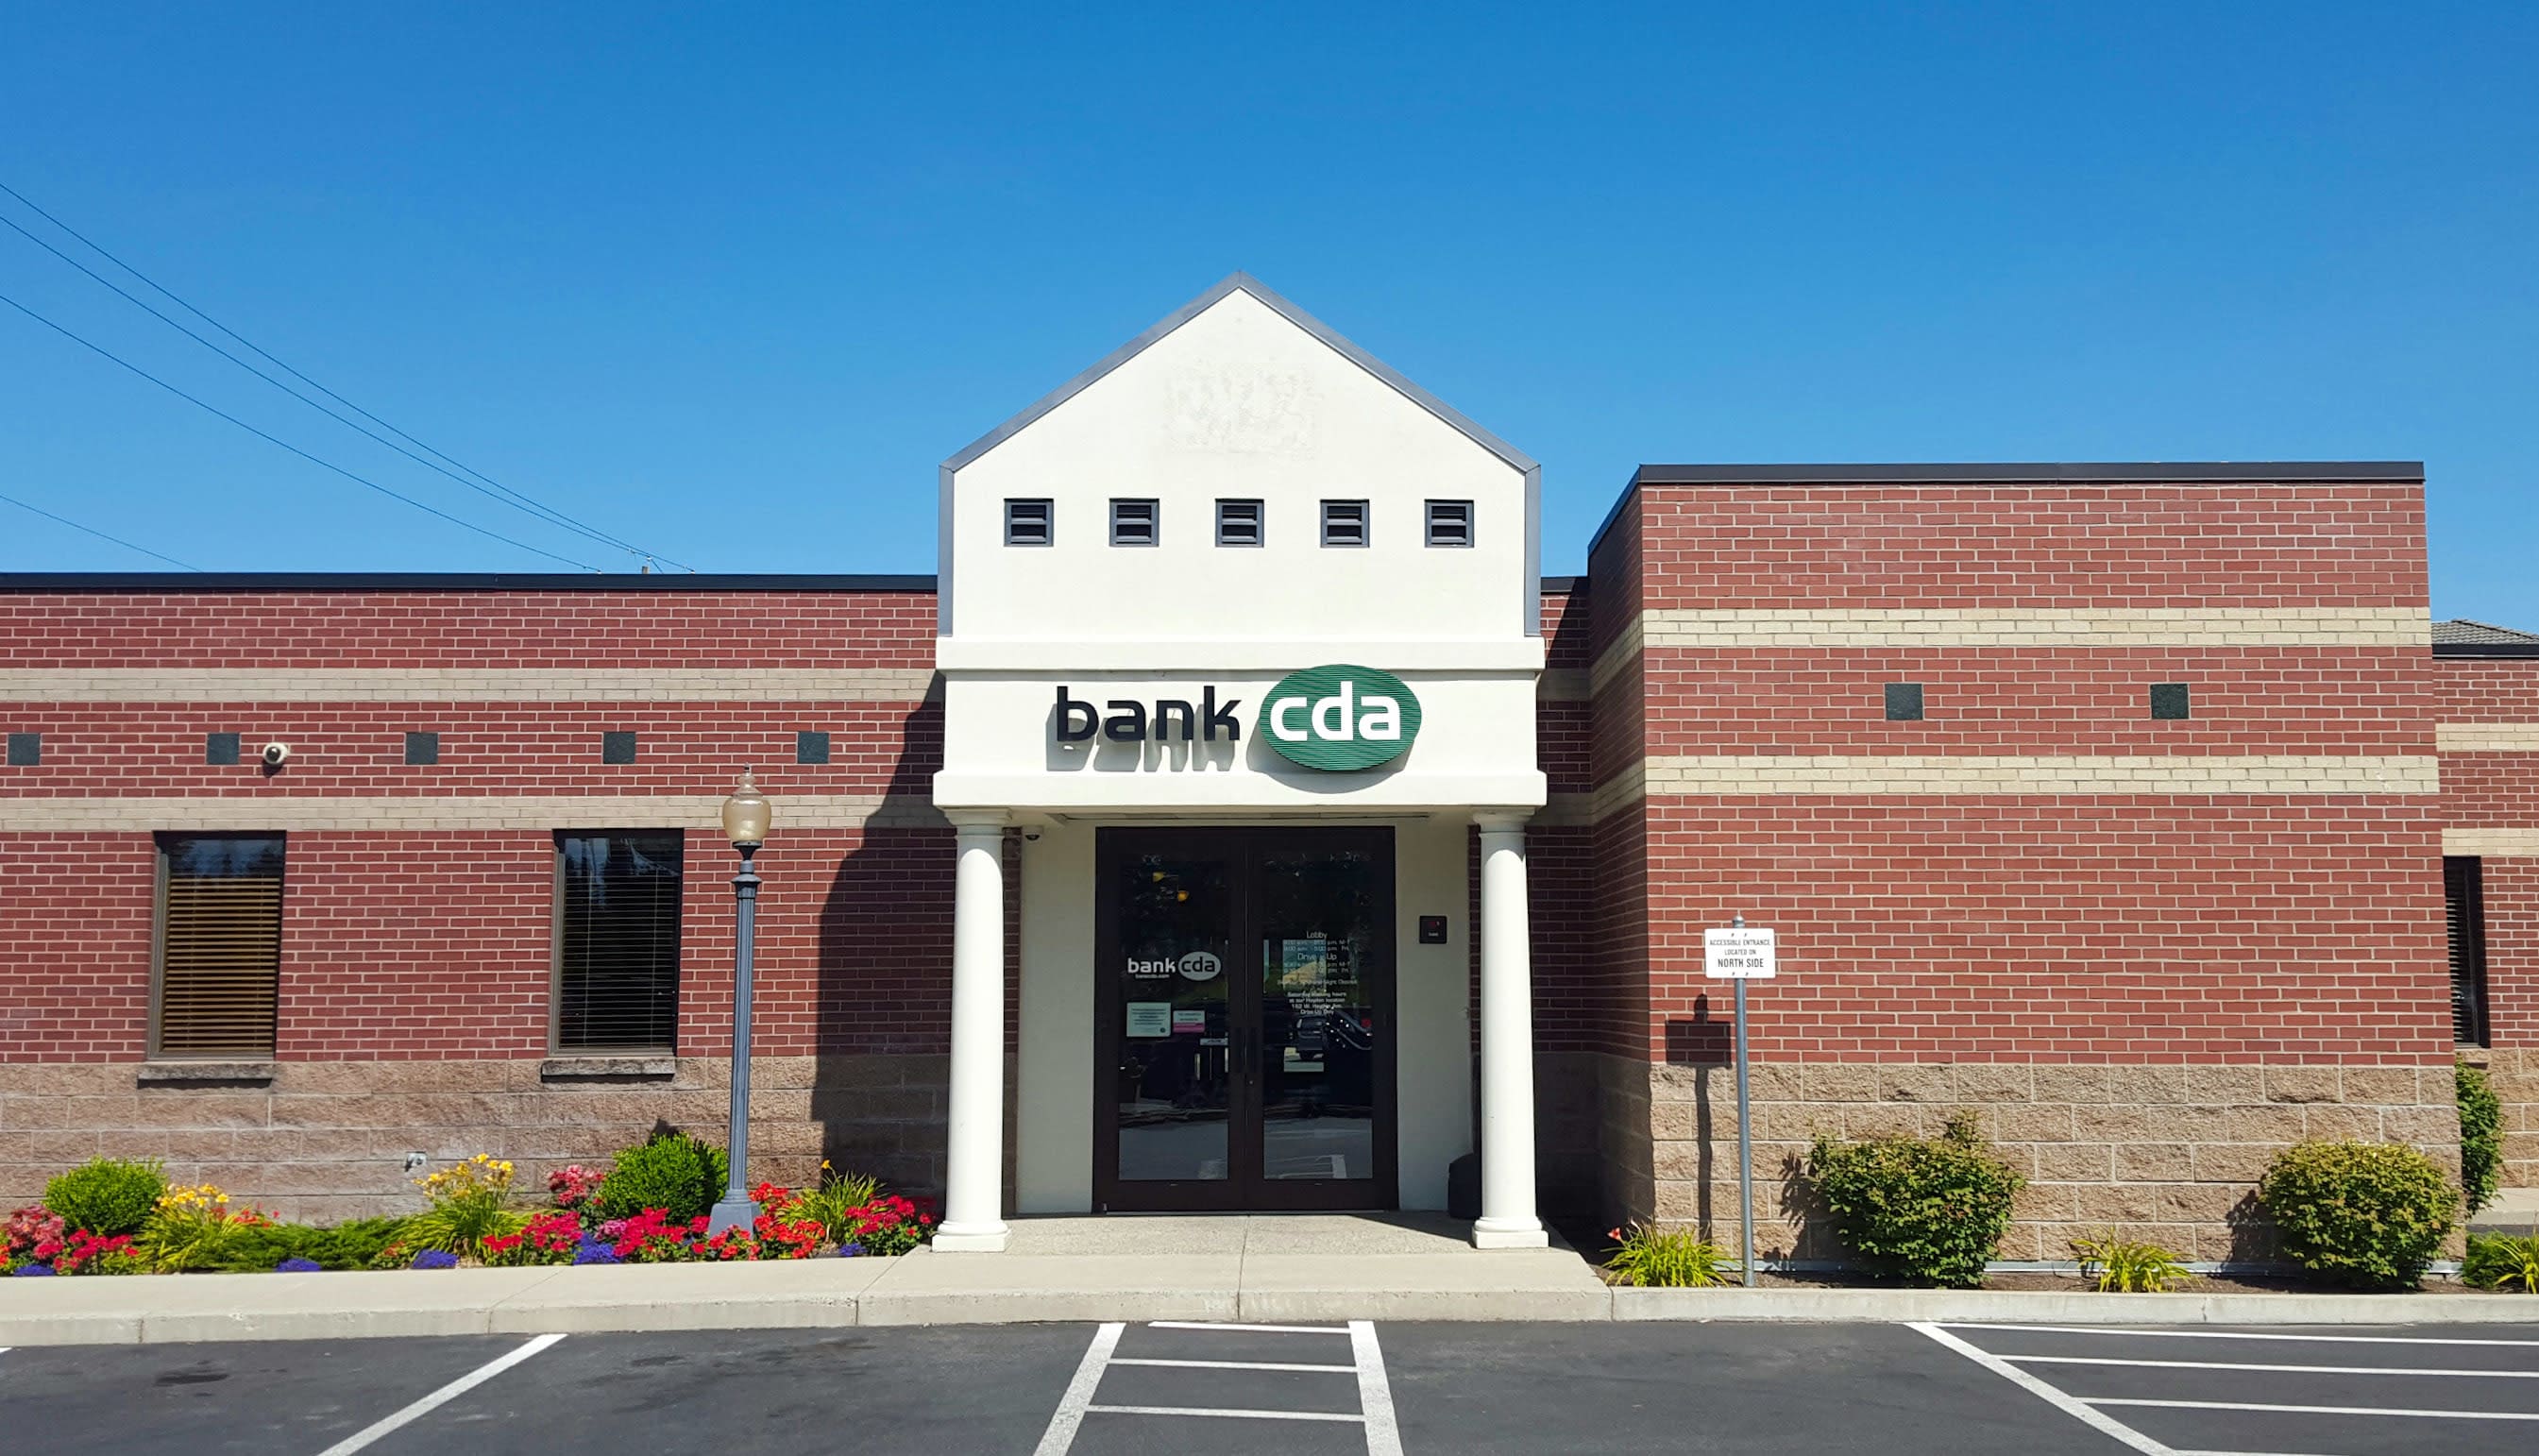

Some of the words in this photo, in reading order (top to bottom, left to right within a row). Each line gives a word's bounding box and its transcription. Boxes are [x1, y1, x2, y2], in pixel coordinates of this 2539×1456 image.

[1057, 686, 1242, 741] bank
[1270, 681, 1400, 741] cda
[1307, 931, 1328, 940] Lobby
[1127, 957, 1176, 973] bank
[1181, 956, 1216, 973] cda
[1718, 957, 1744, 968] NORTH
[1746, 957, 1764, 968] SIDE
